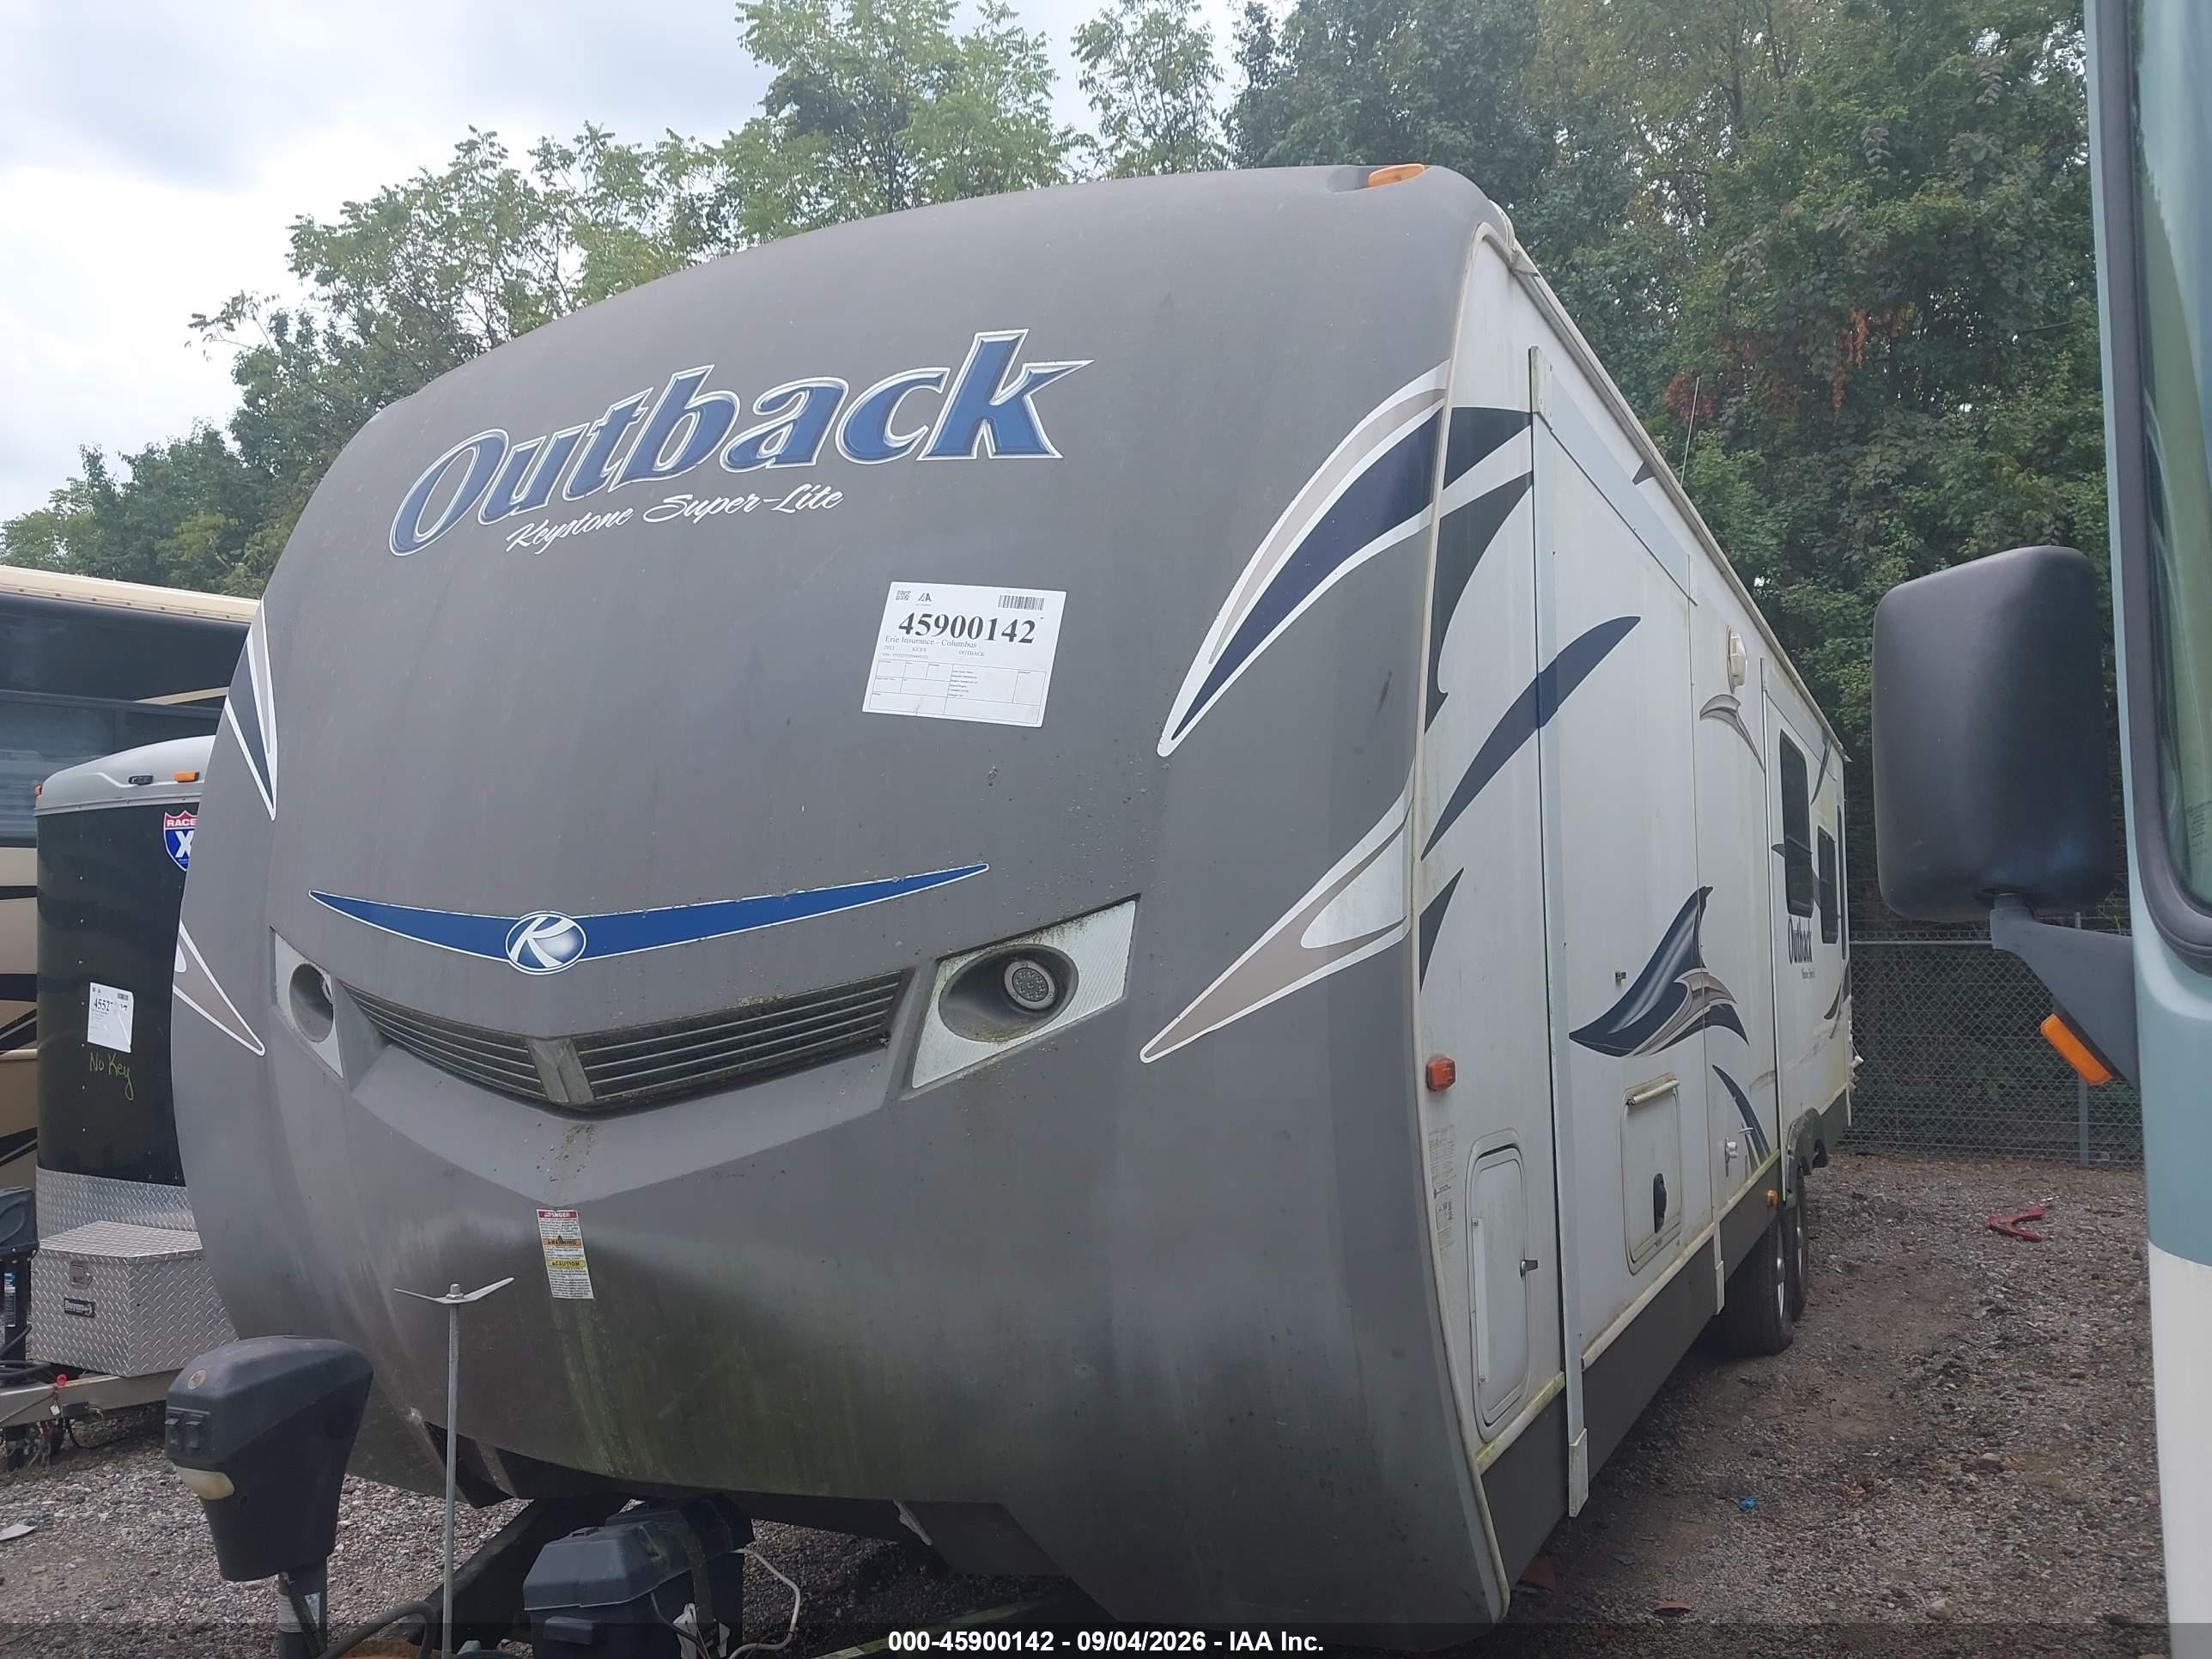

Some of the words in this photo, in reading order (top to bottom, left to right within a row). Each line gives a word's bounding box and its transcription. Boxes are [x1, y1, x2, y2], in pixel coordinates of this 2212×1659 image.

[389, 329, 1093, 556] Outback
[506, 507, 635, 555] Keystone
[643, 483, 845, 524] Super-Lite
[898, 612, 1036, 644] 45900142
[902, 636, 934, 646] Insurance
[941, 639, 977, 648] Columbus
[1788, 915, 1813, 964] Outback
[89, 1052, 105, 1072] No
[108, 1053, 133, 1101] Key
